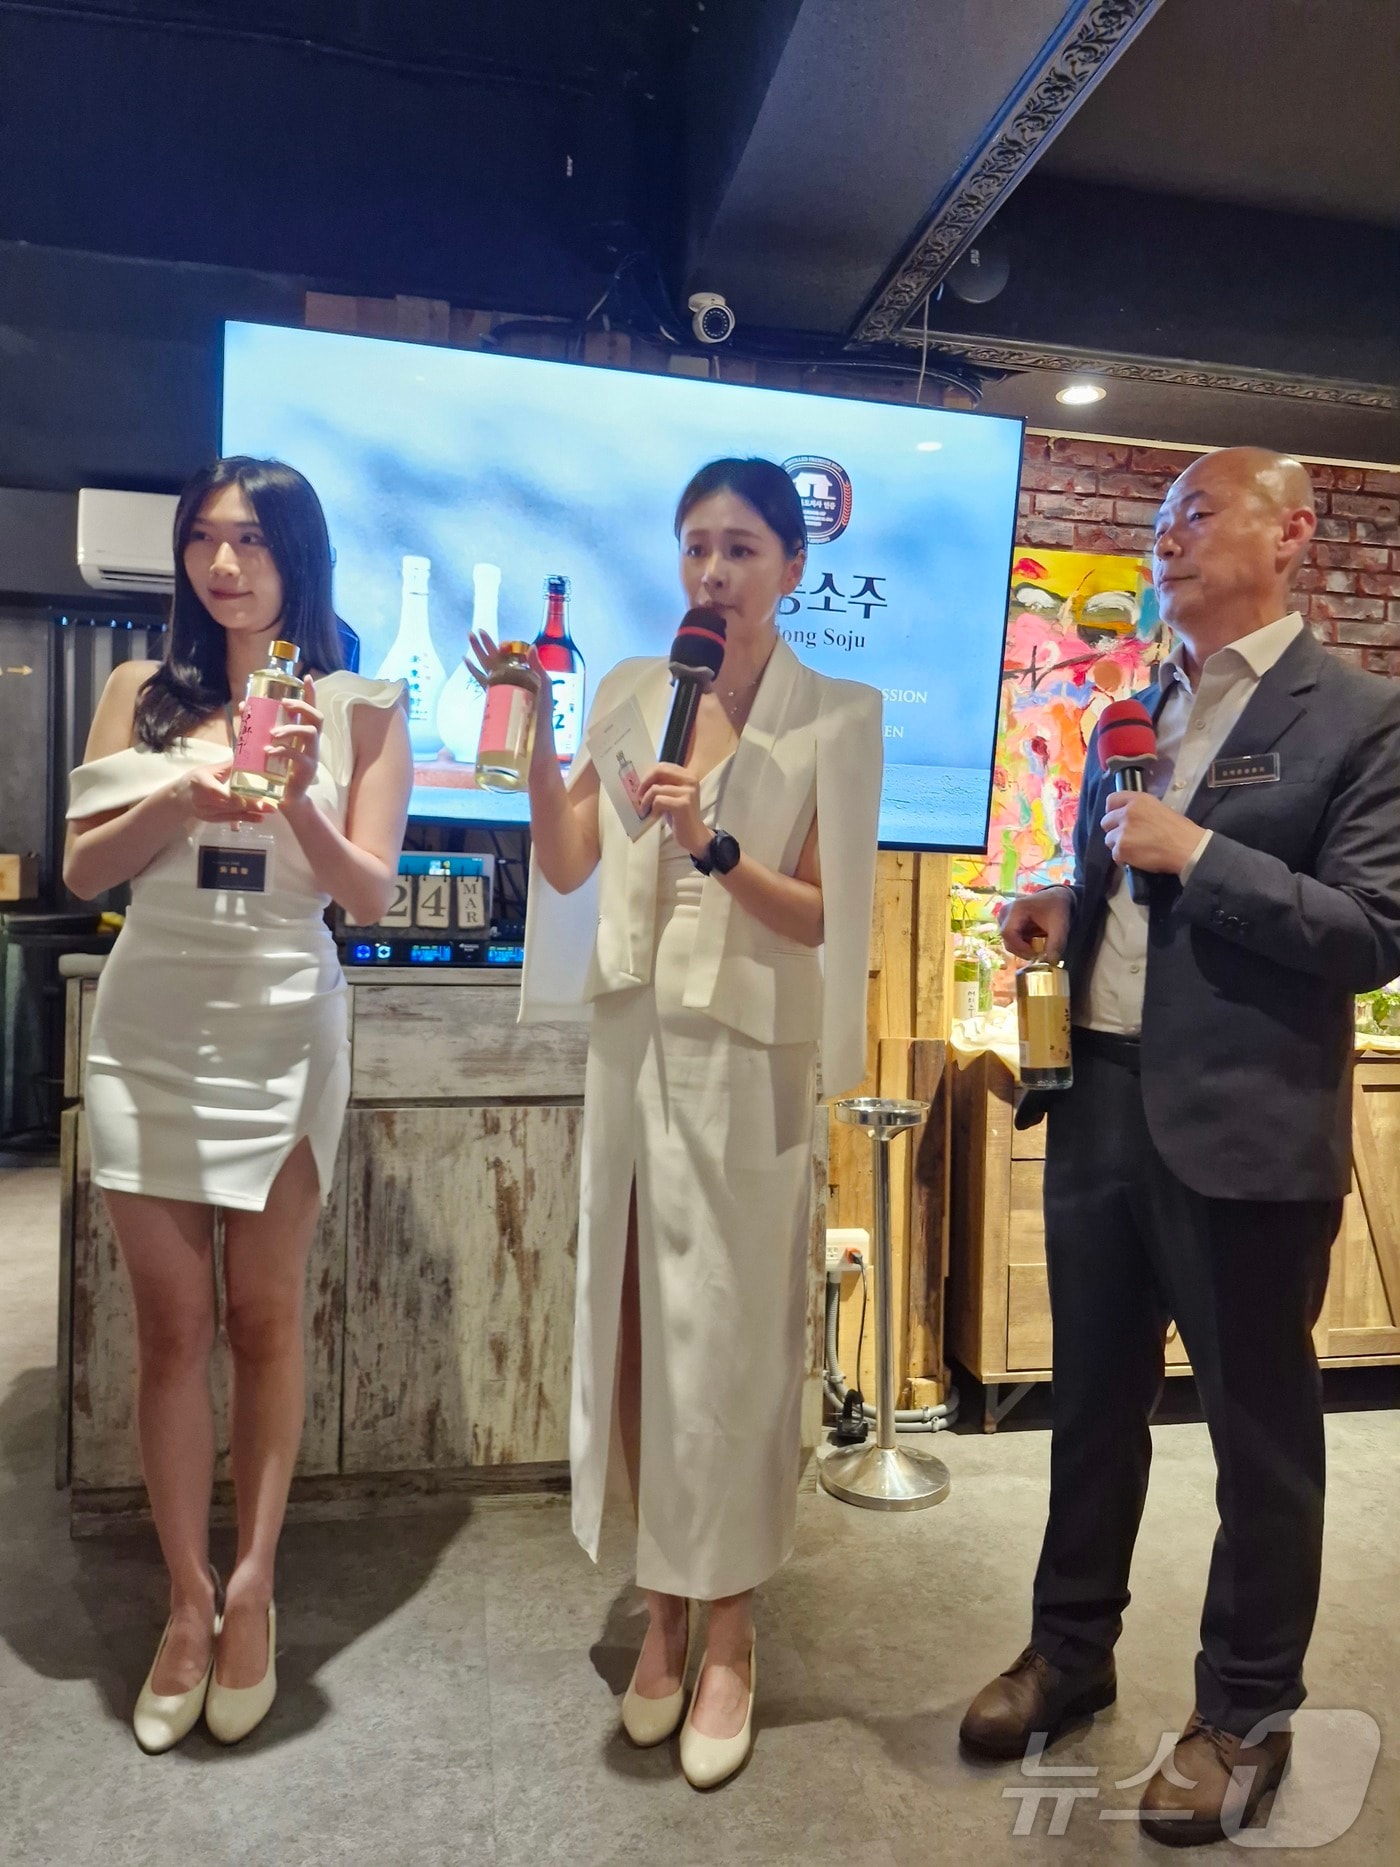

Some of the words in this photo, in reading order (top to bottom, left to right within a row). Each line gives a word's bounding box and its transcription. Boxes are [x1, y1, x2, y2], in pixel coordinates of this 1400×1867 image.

[777, 626, 817, 649] ong
[823, 628, 865, 652] Soju
[463, 883, 478, 923] MAR
